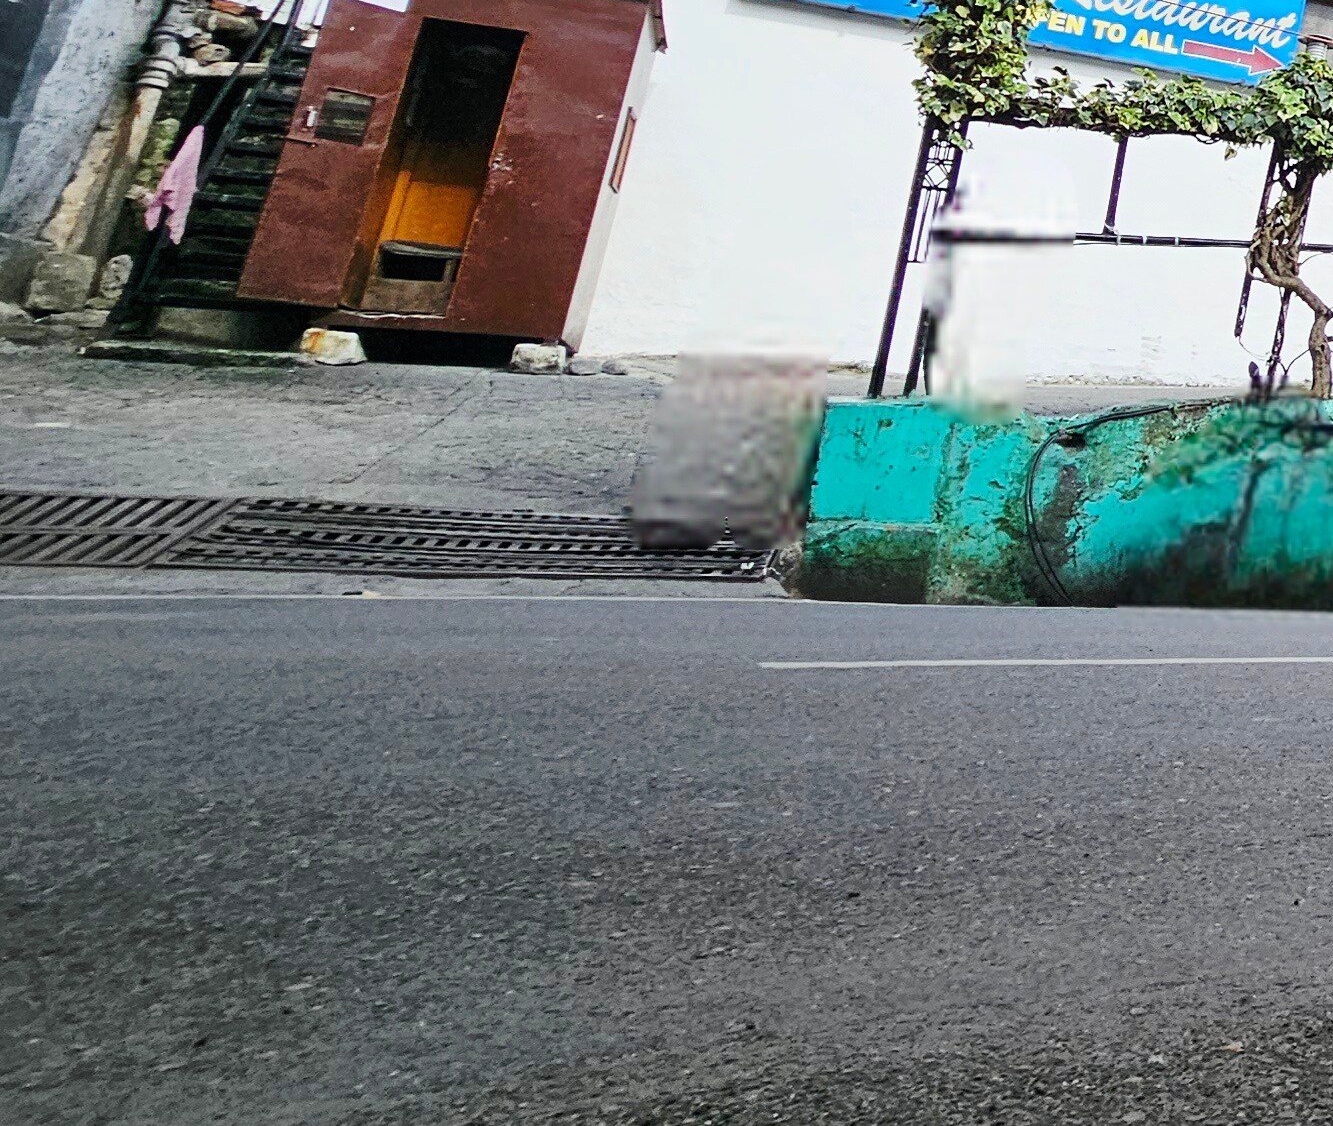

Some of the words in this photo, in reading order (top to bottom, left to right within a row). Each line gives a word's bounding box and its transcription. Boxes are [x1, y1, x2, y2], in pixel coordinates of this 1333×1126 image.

[1030, 6, 1085, 35] PEN
[1091, 18, 1127, 44] TO
[1130, 27, 1180, 55] ALL
